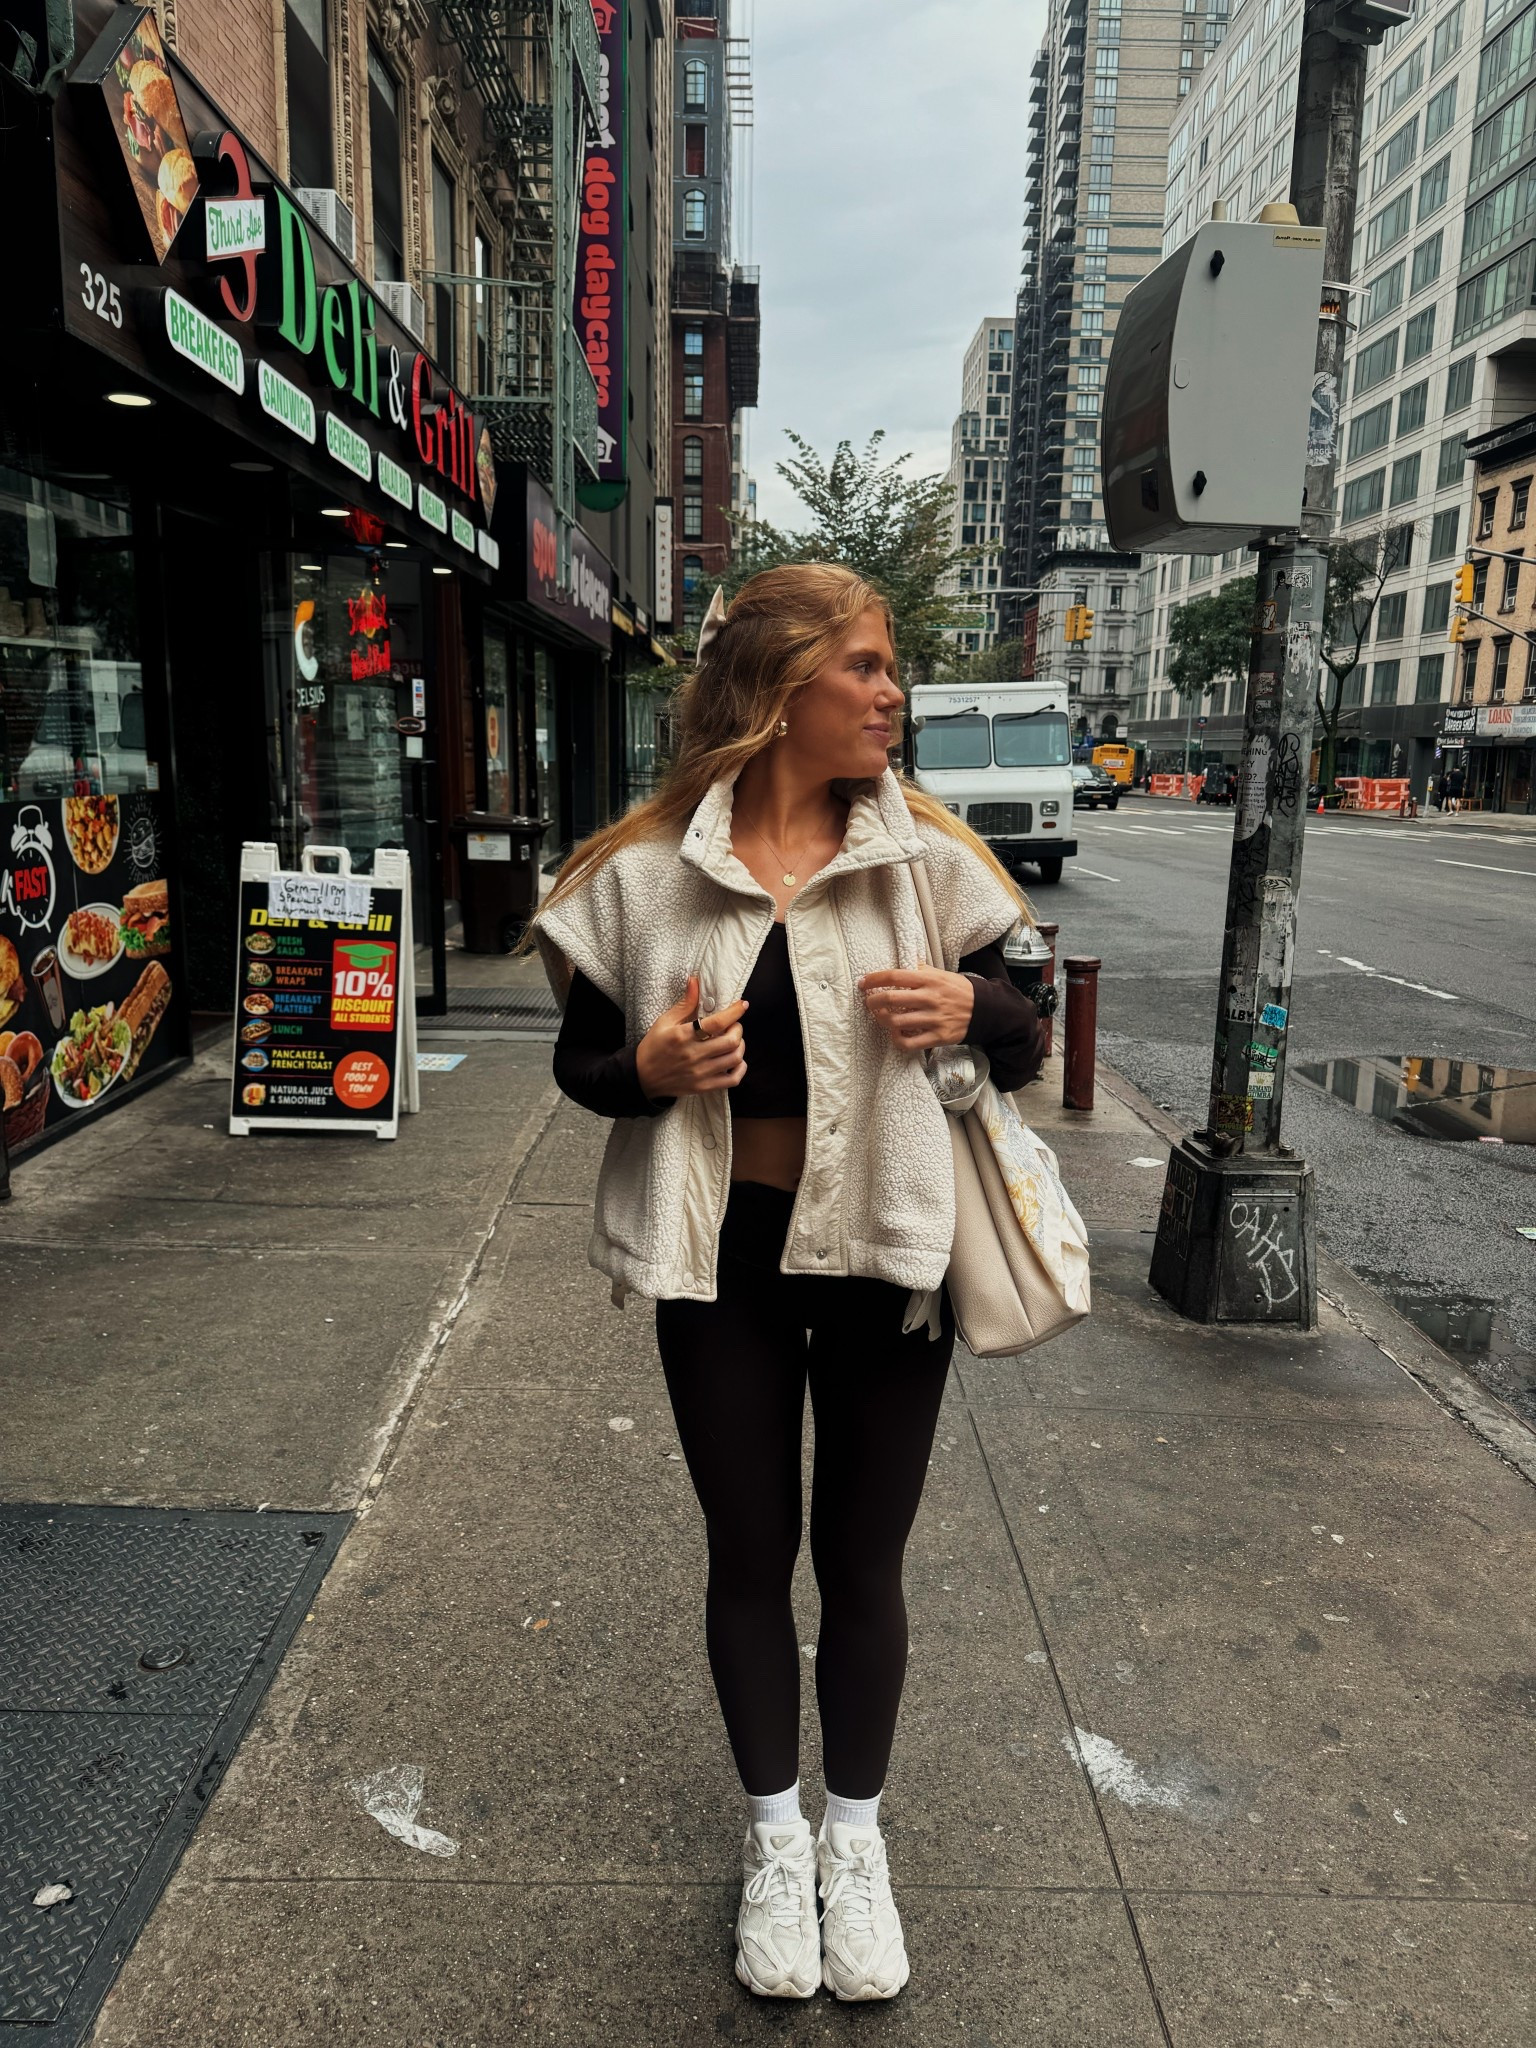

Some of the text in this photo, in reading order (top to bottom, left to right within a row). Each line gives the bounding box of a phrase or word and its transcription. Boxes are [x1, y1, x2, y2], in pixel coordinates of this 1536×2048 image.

[581, 157, 615, 235] dog
[208, 206, 245, 251] Third
[80, 262, 123, 328] 325
[169, 296, 239, 386] BREAKFAST
[274, 182, 476, 502] Deli & Grill
[263, 368, 312, 437] SANDWICH
[328, 416, 369, 477] BEVERAGES
[1488, 708, 1513, 724] LOANS
[15, 866, 48, 901] FAST
[276, 936, 303, 946] FRESH
[276, 946, 306, 956] SALAD
[275, 966, 323, 977] BREAKFAST
[275, 976, 306, 986] WRAPS
[334, 970, 393, 998] 10%
[274, 993, 322, 1005] BREAKFAST
[274, 1004, 314, 1014] PLATTERS
[332, 998, 394, 1014] DISCOUNT
[334, 1012, 391, 1025] ALL STUDENTS
[272, 1025, 303, 1035] LUNCH
[271, 1049, 326, 1060] PANCAKES &
[271, 1060, 333, 1070] FRENCH TOAST
[351, 1062, 374, 1072] BEST
[343, 1073, 380, 1083] FOOD IN
[270, 1085, 334, 1096] NATURAL JUICE
[348, 1083, 374, 1093] TOWN
[269, 1095, 327, 1106] & SMOOTHIES
